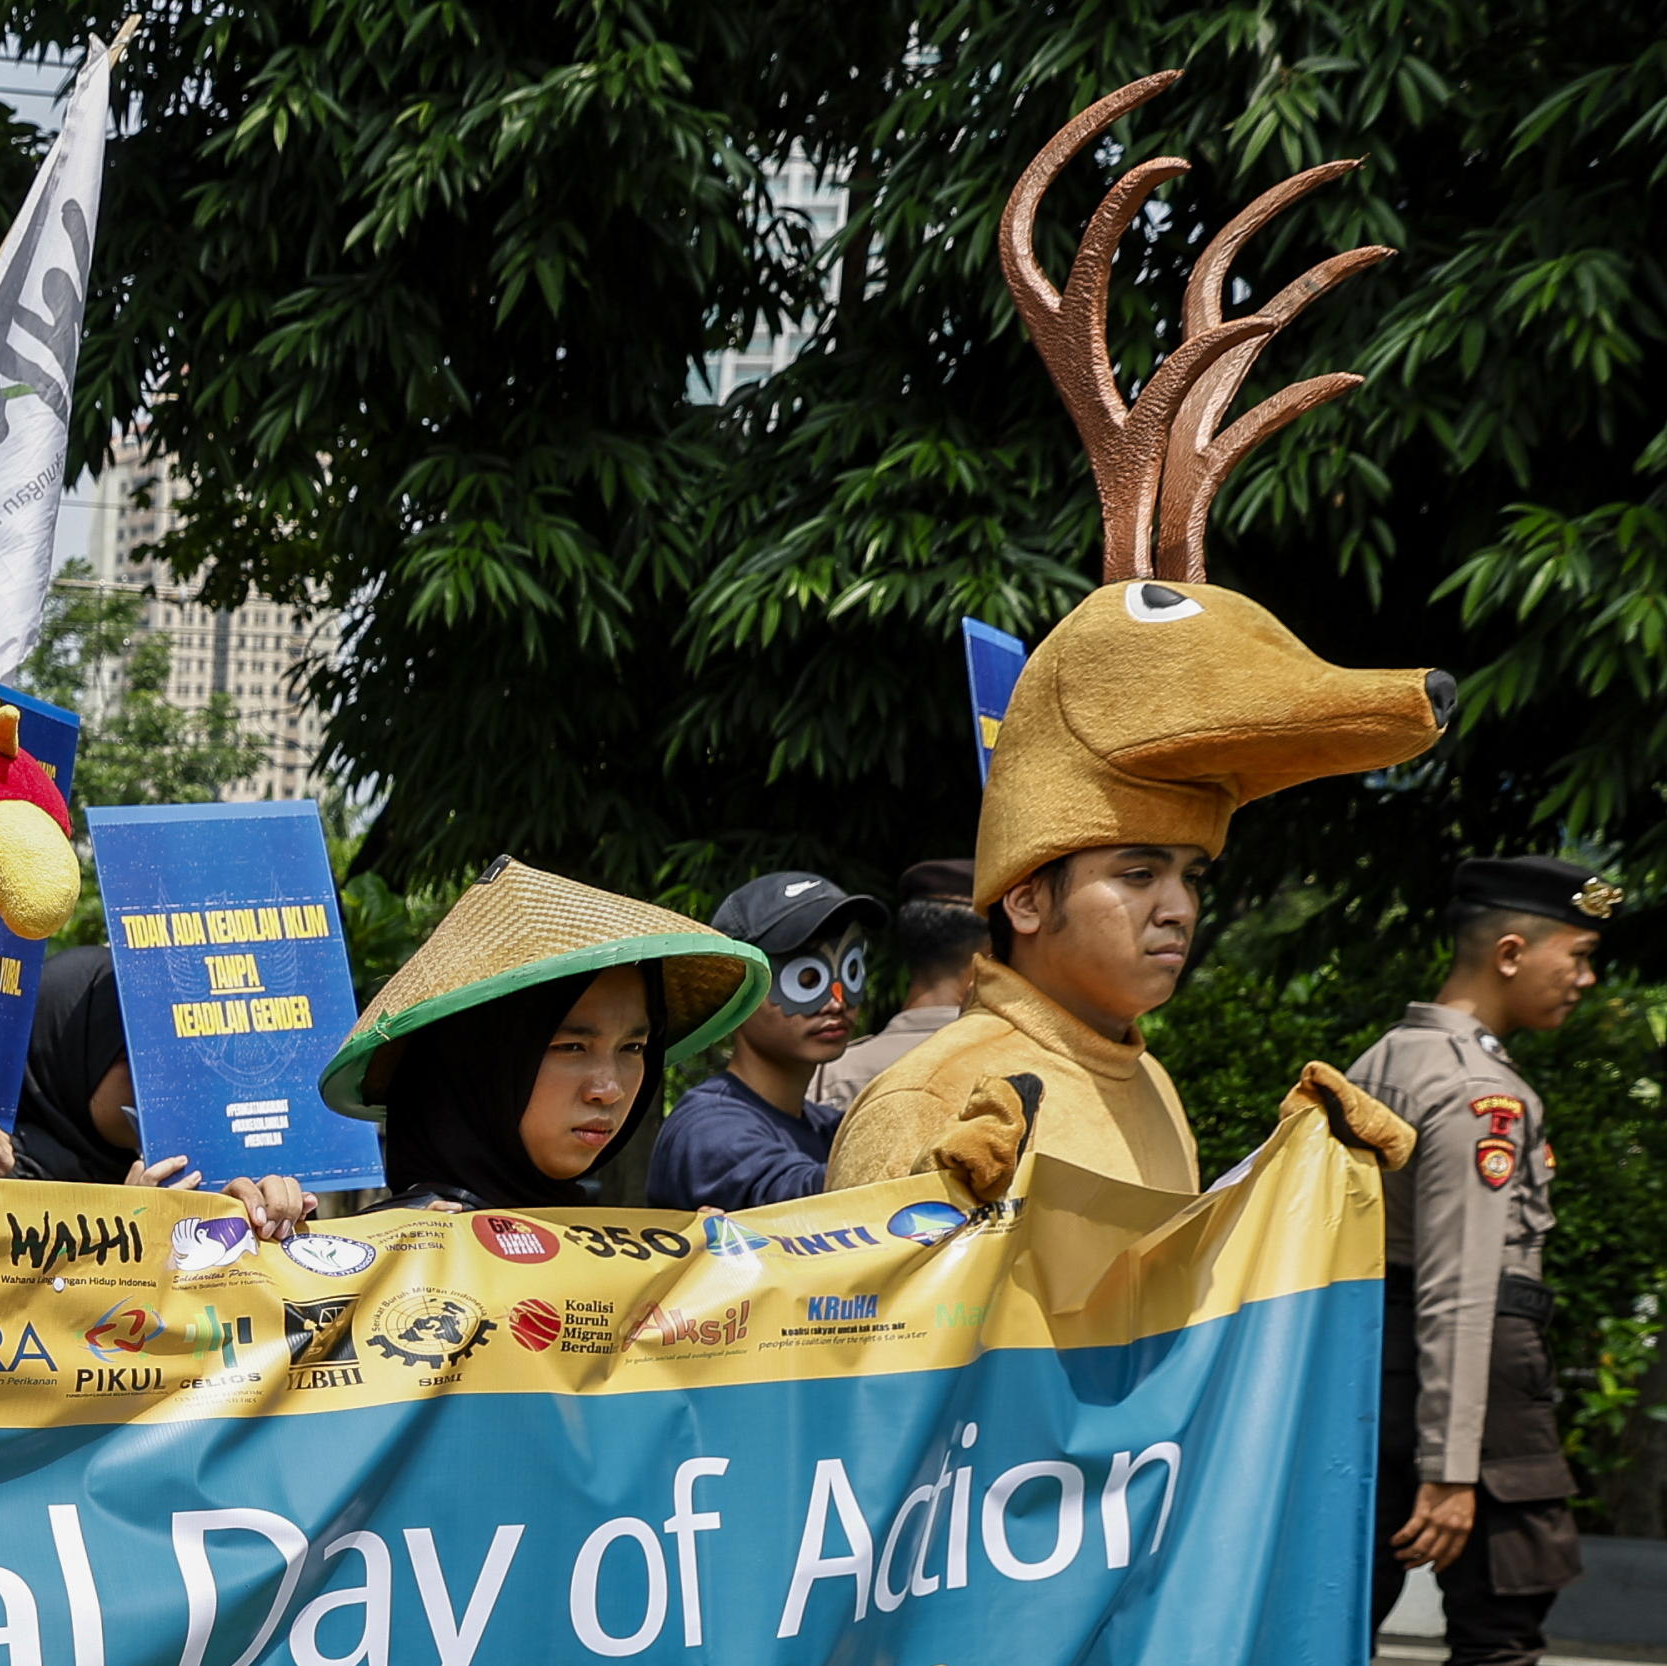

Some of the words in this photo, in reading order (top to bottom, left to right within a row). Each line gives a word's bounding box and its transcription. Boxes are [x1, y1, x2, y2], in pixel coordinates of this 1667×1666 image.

[120, 912, 172, 950] TIDAK
[172, 911, 207, 947] ADA
[204, 906, 283, 944] KEADILAN
[281, 903, 331, 940] IKLIM
[204, 953, 262, 991] TANPA
[171, 999, 250, 1038] KEADILAN
[249, 995, 314, 1033] GENDER
[6, 1210, 144, 1275] WALHI
[568, 1224, 692, 1261] 350
[1, 1274, 37, 1284] Wahana
[88, 1277, 117, 1289] Hidup
[118, 1278, 158, 1288] Indonesia
[564, 1299, 615, 1314] Koalisi
[806, 1293, 880, 1322] KRuHA
[564, 1313, 609, 1327] Buruh
[620, 1299, 751, 1353] Aksi!
[562, 1327, 613, 1342] Migran
[883, 1333, 897, 1342] to
[896, 1330, 928, 1342] water
[6, 1376, 58, 1386] Perikanan
[74, 1367, 167, 1393] PIKUL
[178, 1372, 263, 1390] CELIOS
[285, 1366, 366, 1392] YLBHI
[418, 1372, 464, 1388] SBMI
[568, 1455, 731, 1660] of
[775, 1421, 1184, 1640] Action
